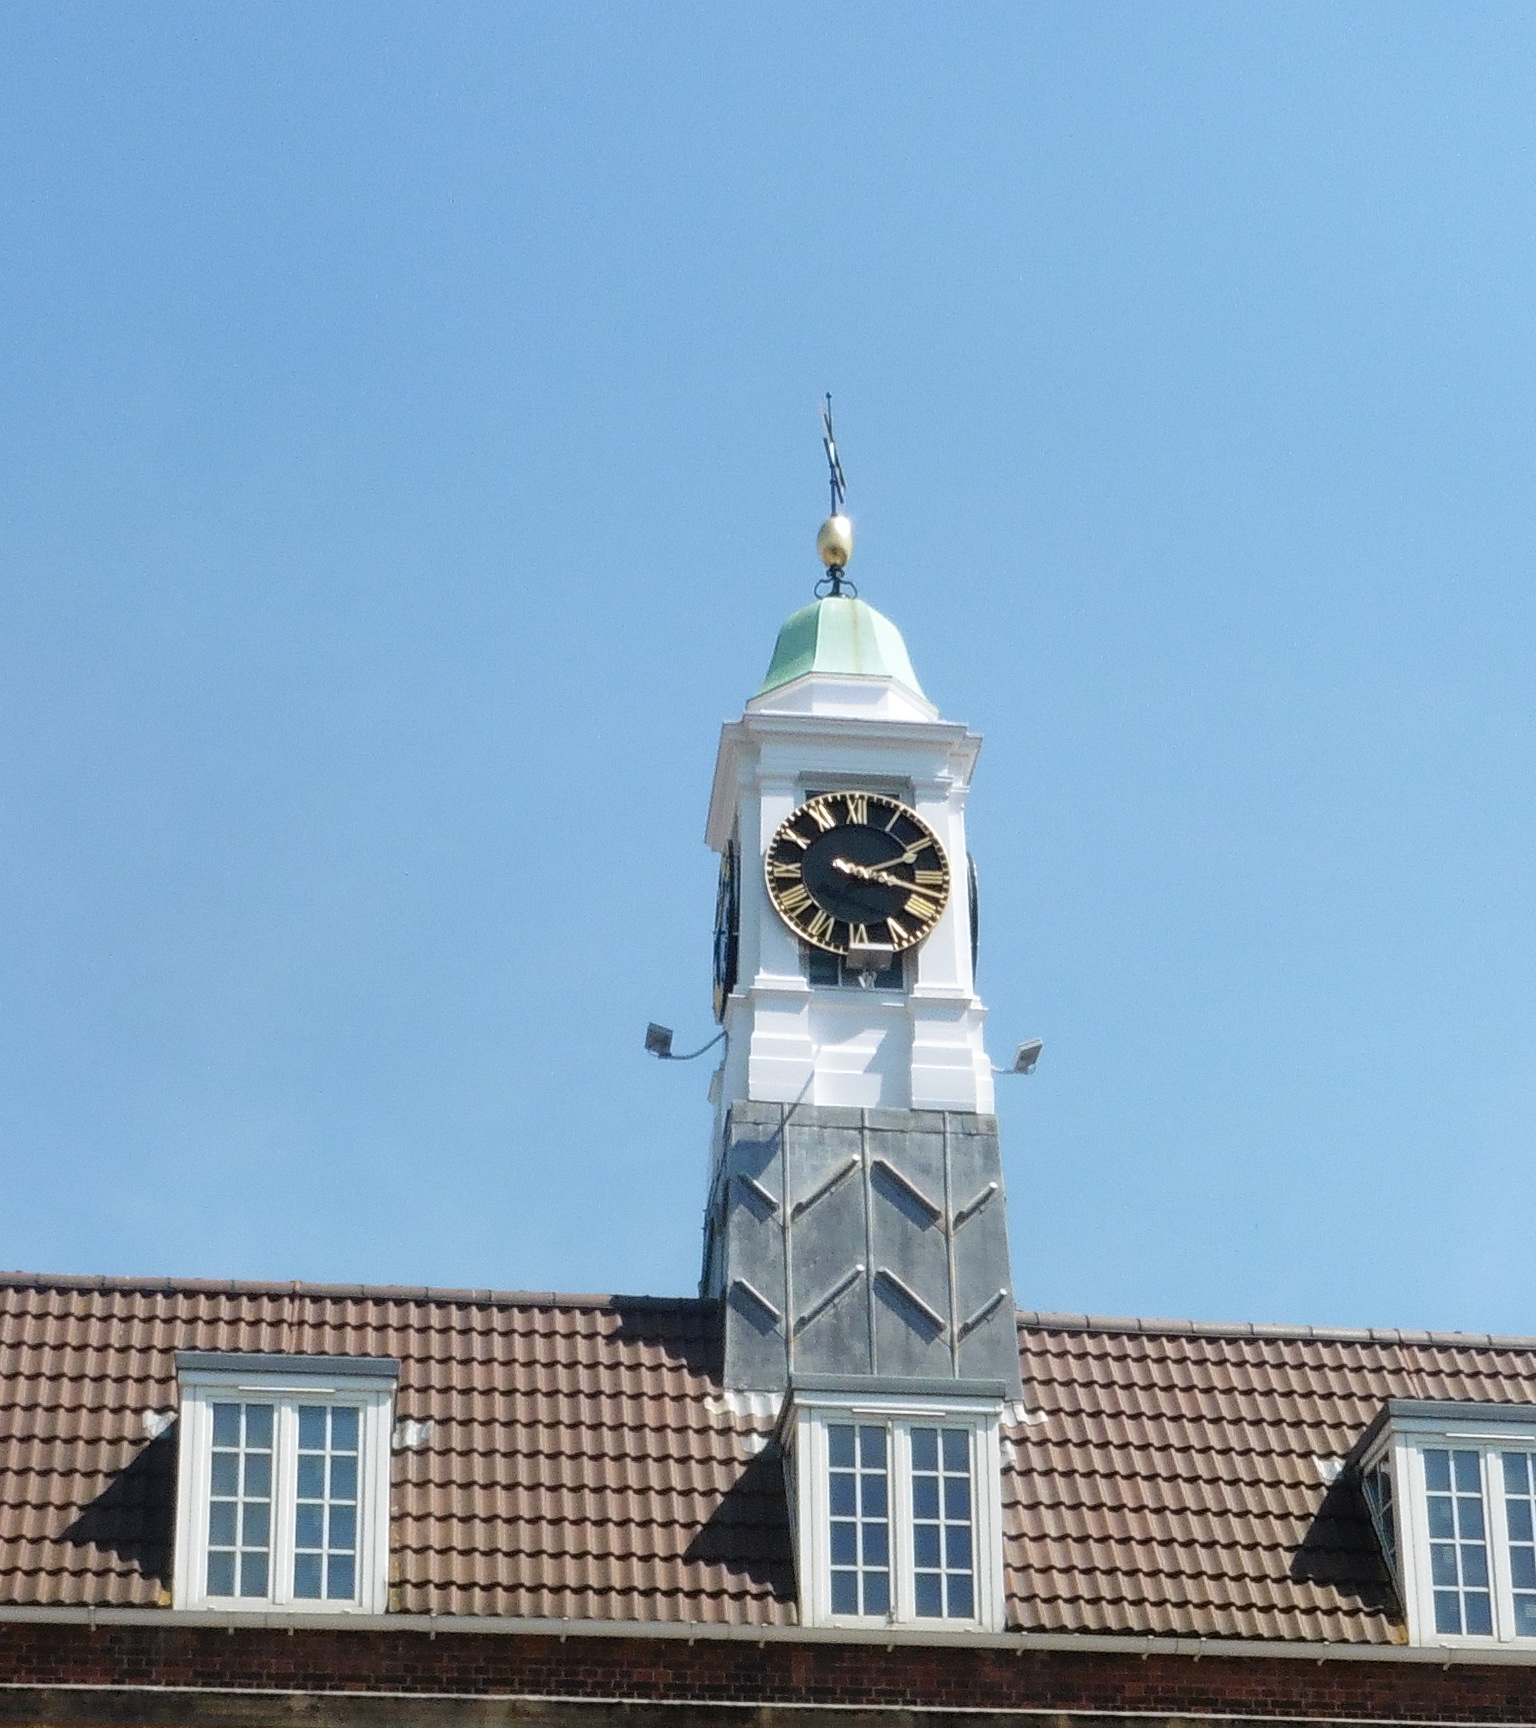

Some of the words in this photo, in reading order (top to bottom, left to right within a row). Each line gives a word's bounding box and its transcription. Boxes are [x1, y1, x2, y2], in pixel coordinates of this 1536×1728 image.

[809, 803, 836, 832] XI
[846, 794, 868, 825] XII
[782, 828, 811, 849] X
[773, 861, 801, 878] IX
[915, 870, 943, 884] III
[779, 883, 812, 917] VIII
[808, 910, 835, 942] VII
